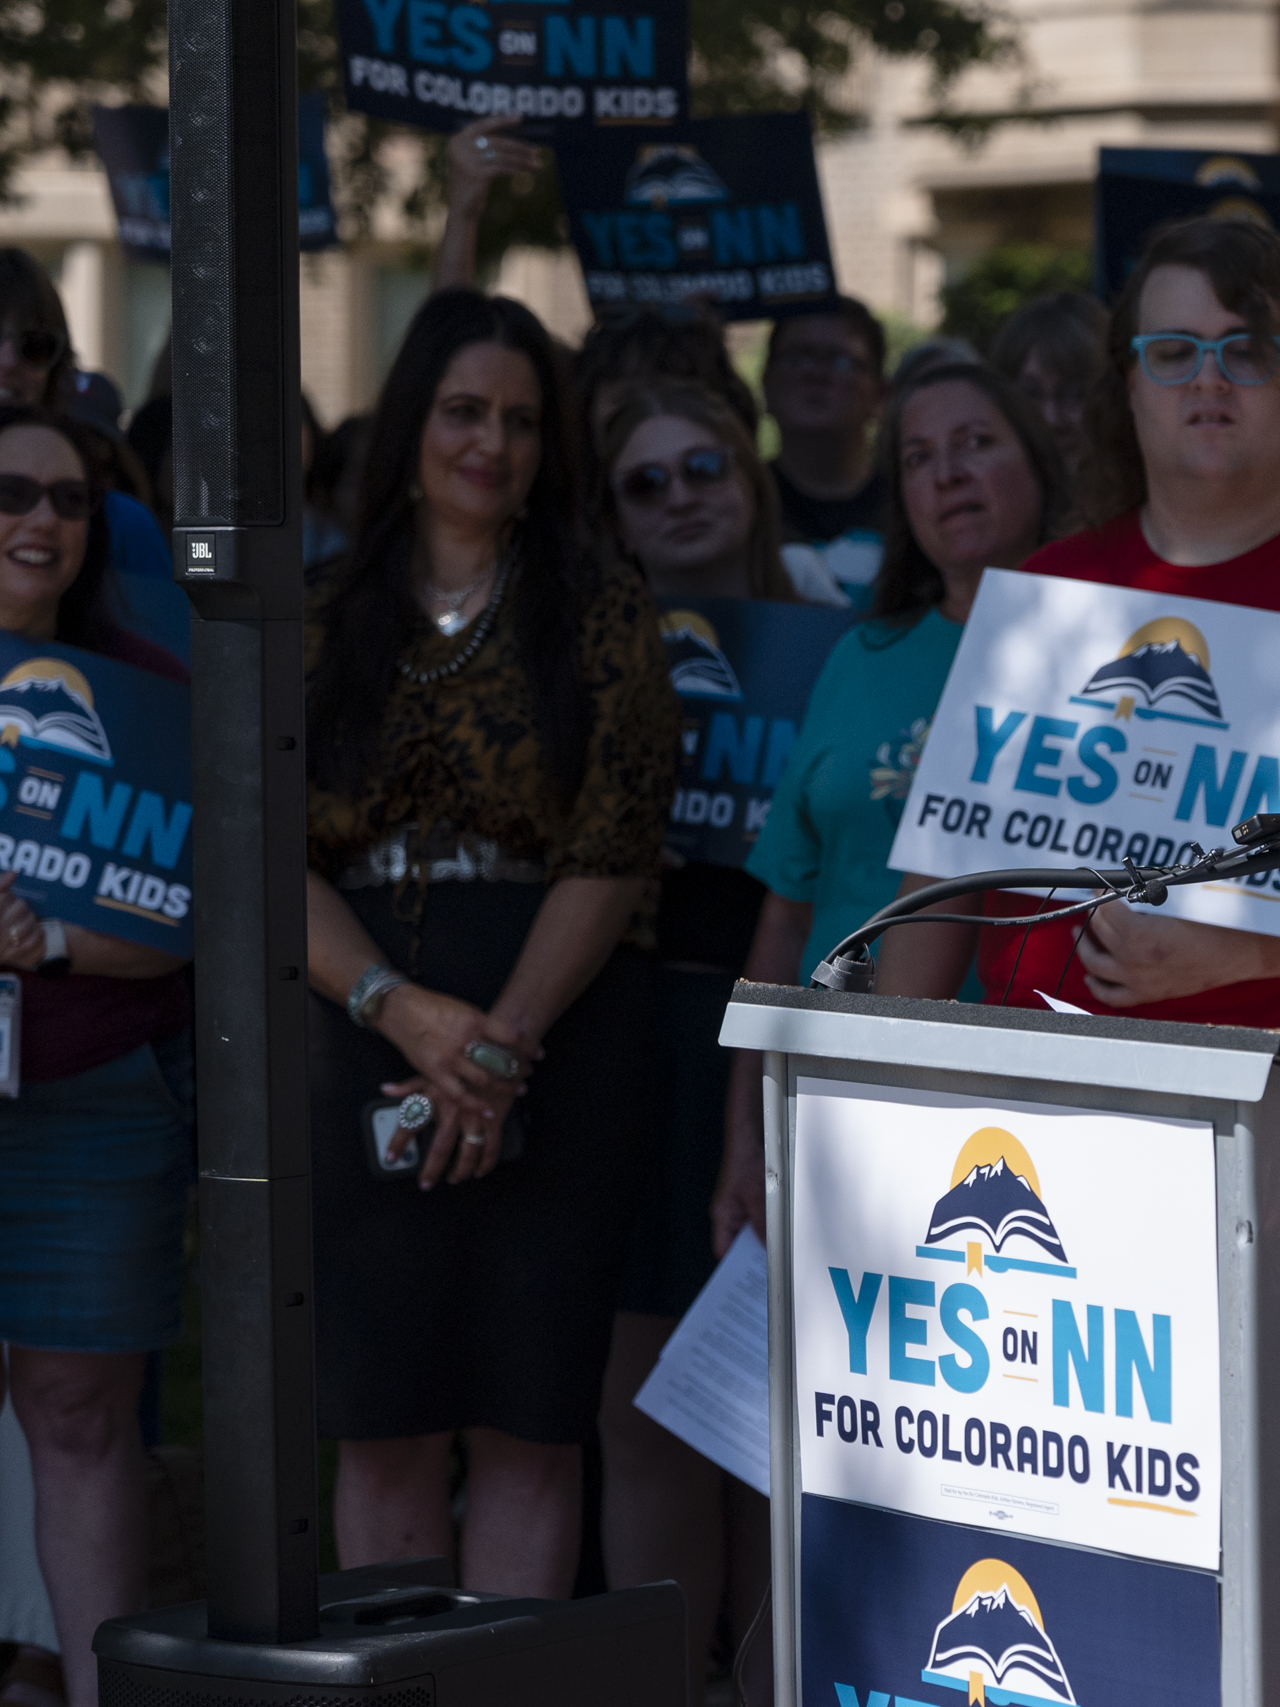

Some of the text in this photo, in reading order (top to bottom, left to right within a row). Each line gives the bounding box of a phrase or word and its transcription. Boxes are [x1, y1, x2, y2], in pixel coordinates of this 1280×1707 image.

[364, 0, 656, 79] YES ON NN
[350, 53, 680, 119] FOR COLORADO KIDS
[581, 211, 678, 268] YES
[709, 201, 805, 266] NN
[191, 542, 212, 558] JBL
[970, 704, 1127, 804] YES
[1133, 760, 1173, 789] ON
[18, 776, 64, 811] ON
[60, 770, 194, 872] NN
[917, 794, 988, 839] FOR
[98, 861, 192, 919] KIDS
[828, 1266, 990, 1394] YES
[1002, 1326, 1038, 1365] ON
[1052, 1298, 1172, 1425] NN
[814, 1391, 1200, 1503] FOR COLORADO KIDS
